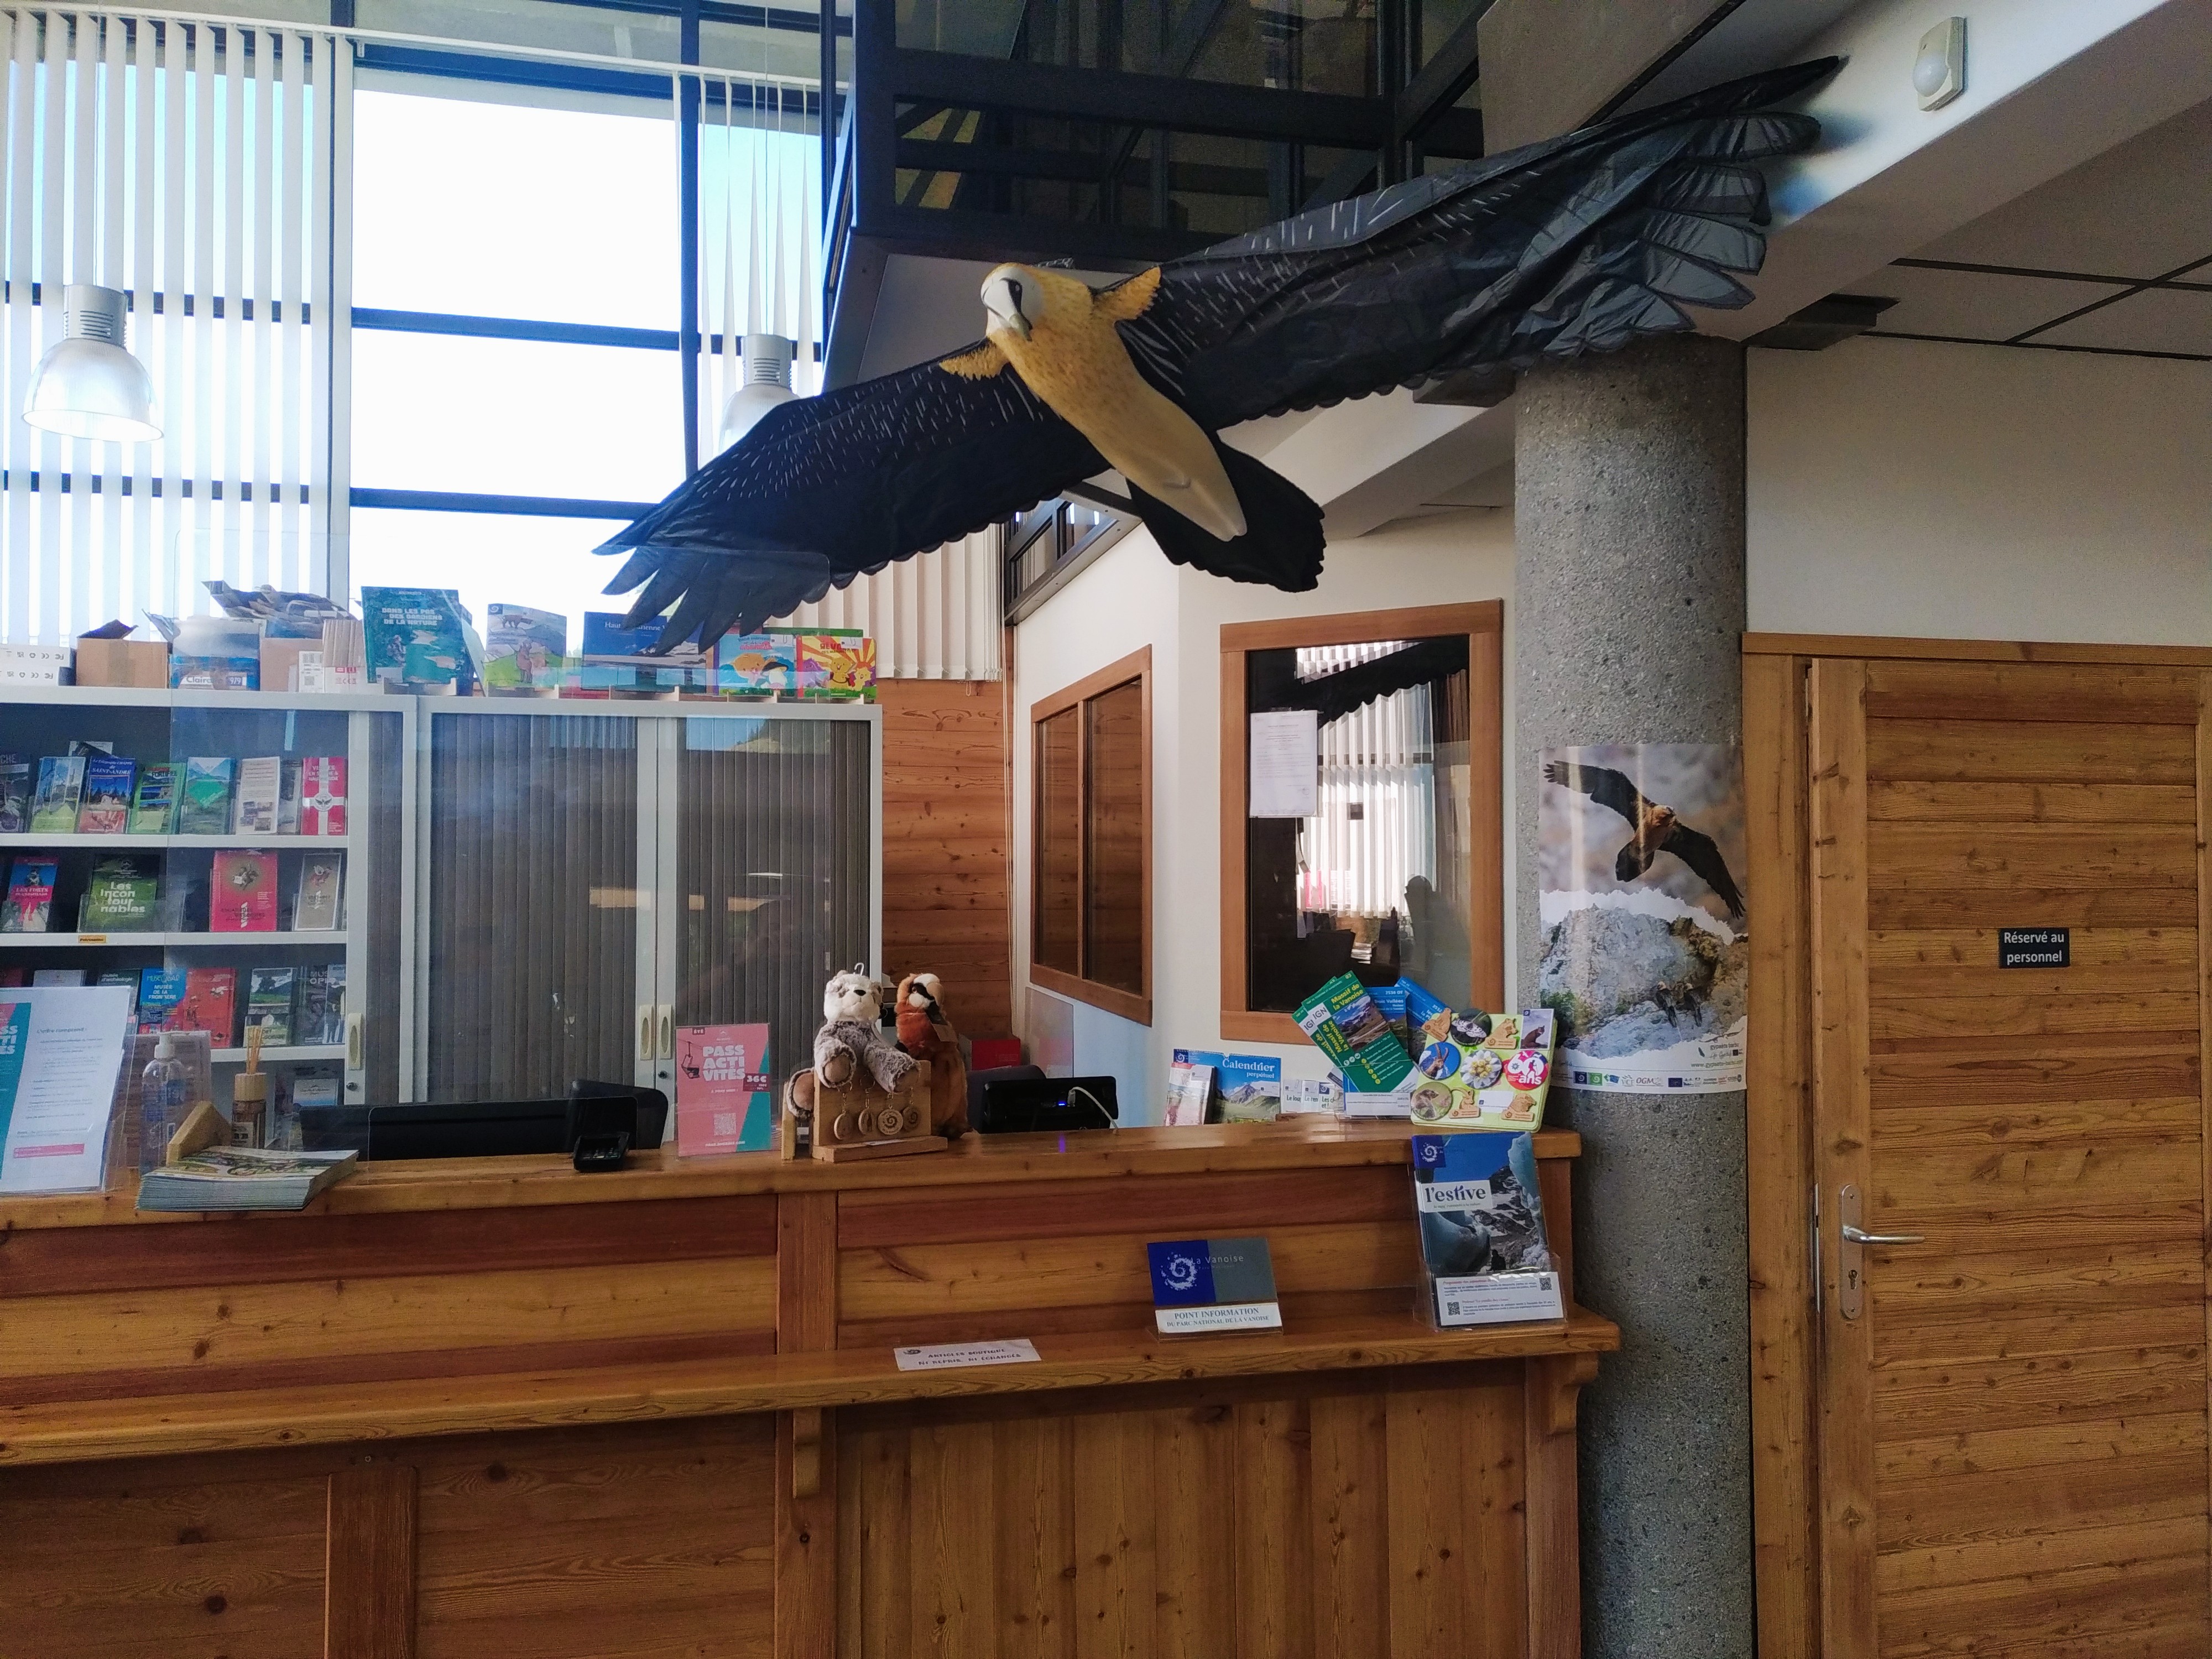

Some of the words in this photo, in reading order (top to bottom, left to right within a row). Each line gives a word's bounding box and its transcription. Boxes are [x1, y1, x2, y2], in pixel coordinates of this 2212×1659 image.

[111, 881, 132, 890] Les
[100, 889, 135, 897] Incon
[2004, 931, 2048, 943] Réservé
[2051, 933, 2064, 943] au
[2007, 950, 2062, 966] personnel
[1331, 988, 1351, 1004] Massif
[1339, 989, 1364, 1005] Vanoise
[1312, 1007, 1327, 1020] IGN
[1322, 1024, 1329, 1032] de
[1328, 1020, 1344, 1044] Vanoise
[1326, 1032, 1343, 1053] Massif
[703, 1045, 745, 1057] PASS
[703, 1056, 745, 1070] ACTI
[1222, 1058, 1275, 1072] Calendrier
[1507, 1053, 1544, 1073] 60
[703, 1067, 745, 1081] VITÉS
[1520, 1074, 1542, 1085] ans
[1425, 1185, 1486, 1202] l'estive
[1205, 1255, 1244, 1264] Vanoise
[1175, 1311, 1199, 1319] POINT
[1201, 1307, 1259, 1318] INFORMATION
